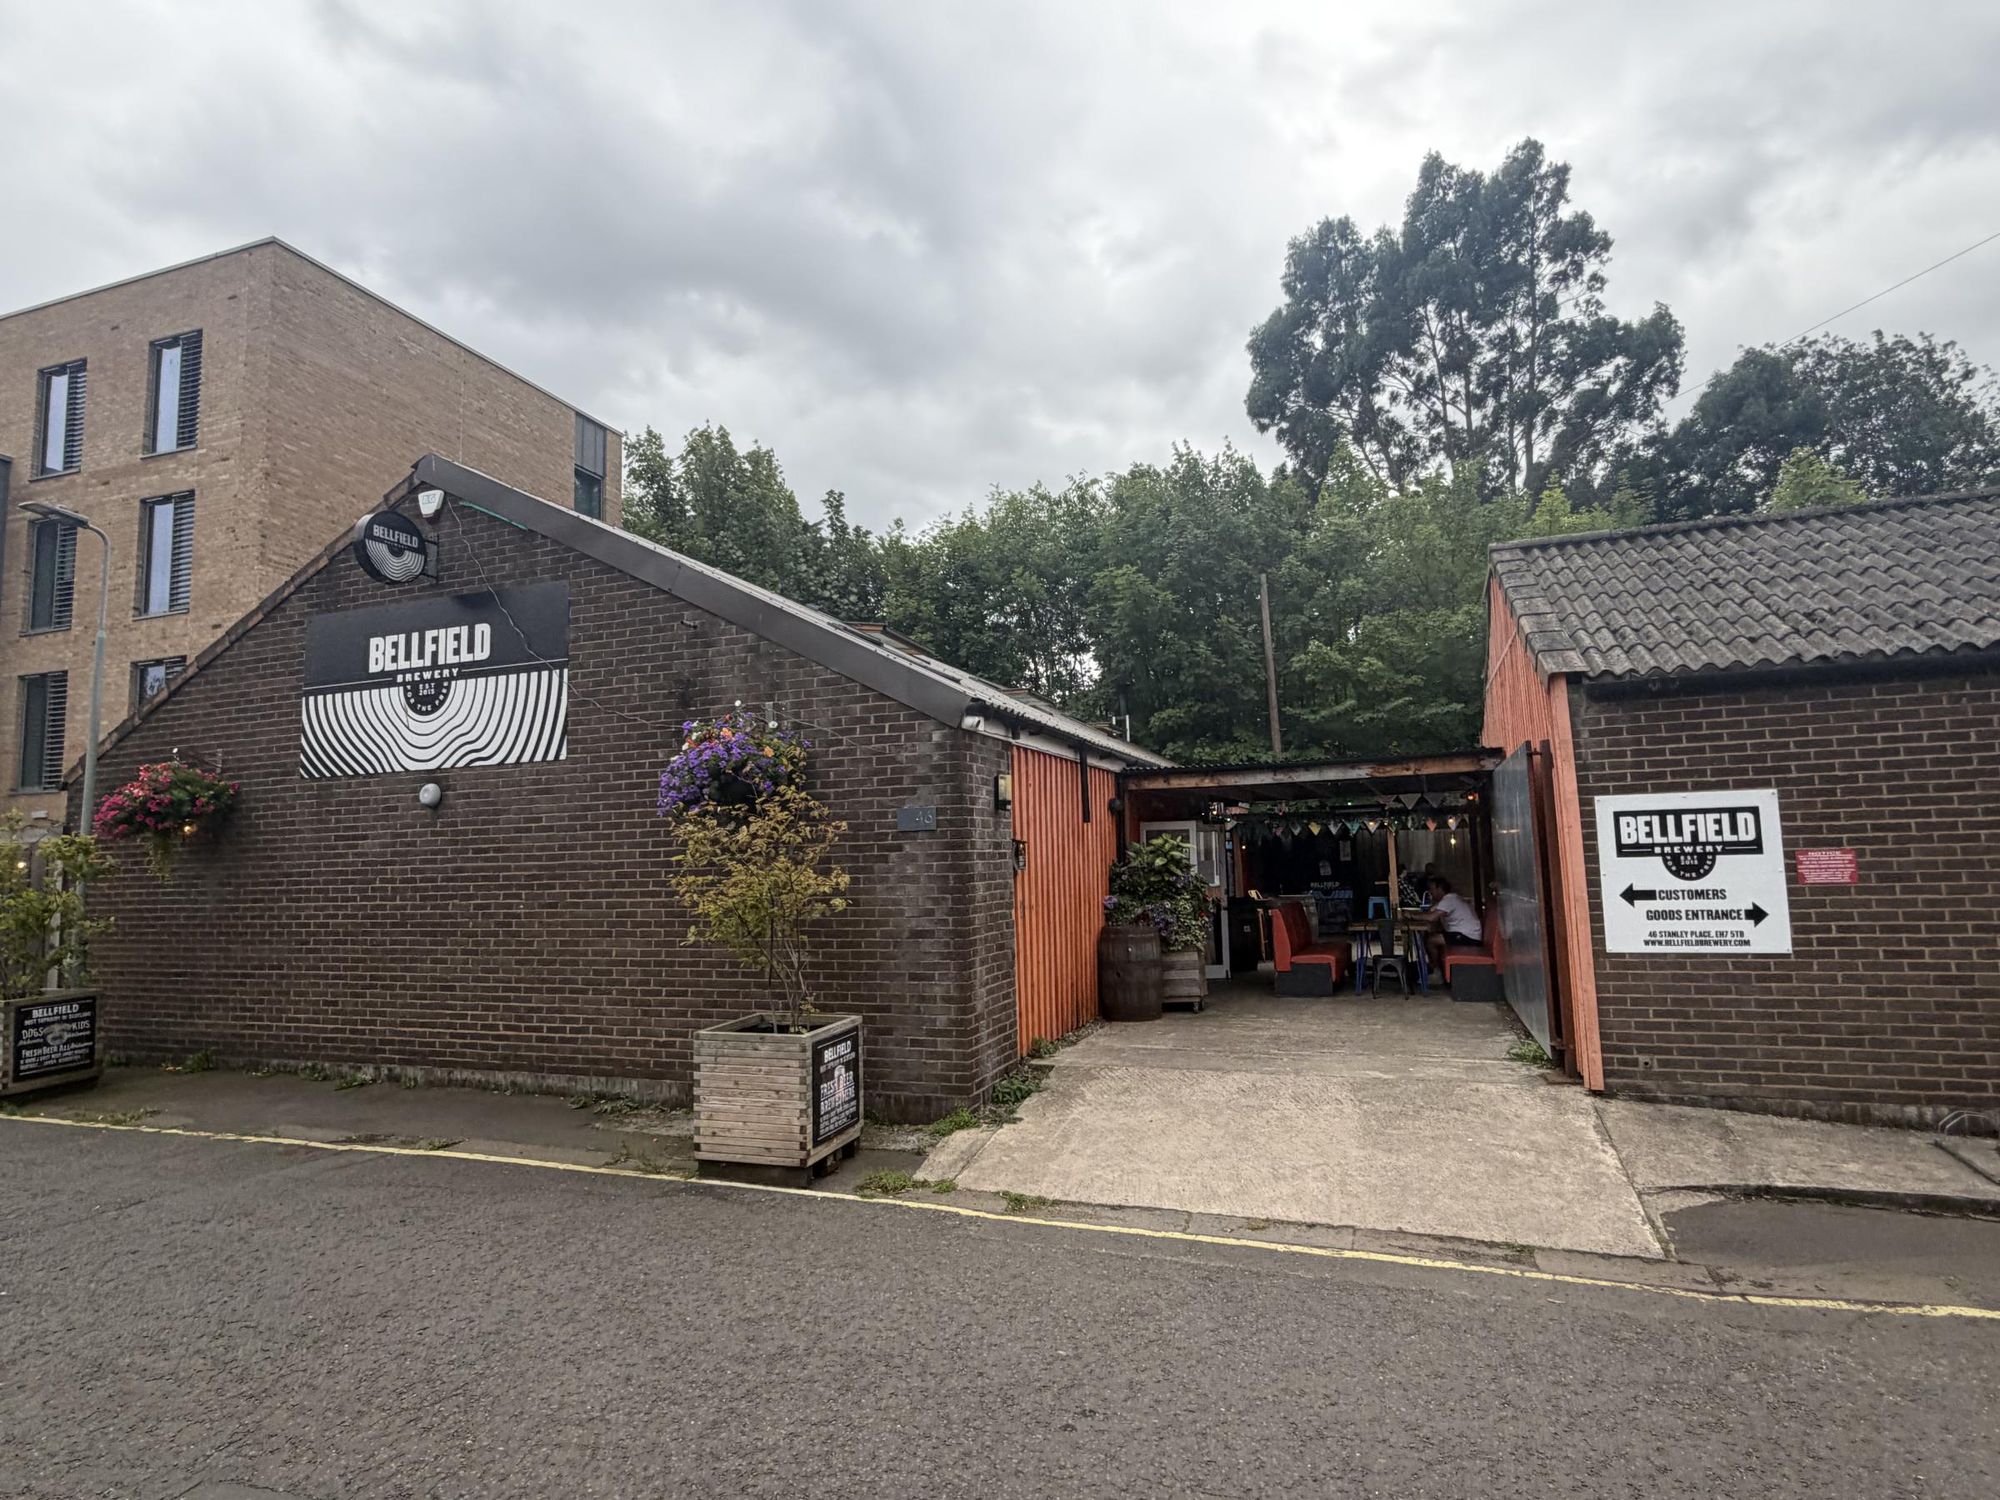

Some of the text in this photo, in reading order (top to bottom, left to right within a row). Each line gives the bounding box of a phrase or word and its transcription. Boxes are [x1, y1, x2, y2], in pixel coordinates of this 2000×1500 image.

[372, 524, 419, 548] BELLFIELD
[369, 623, 491, 673] BELLFIELD
[396, 668, 459, 683] BREWERY
[1618, 812, 1756, 845] BELLFIELD
[1654, 845, 1723, 853] BREWERY
[1657, 889, 1727, 901] CUSTOMERS
[1646, 909, 1743, 921] GOODS ENTRANCE
[1648, 930, 1657, 938] 46
[1658, 930, 1688, 938] STANLEY
[1715, 930, 1728, 938] EH7
[1730, 930, 1745, 938] 5TB
[1643, 939, 1751, 947] WWW.BELLFIELDBREWERY.COM
[32, 1004, 79, 1018] BELLFIELD
[72, 1021, 90, 1030] KIDS
[22, 1028, 43, 1039] DOGS
[22, 1049, 42, 1058] FRESH
[824, 1040, 852, 1063] BELLFIELD
